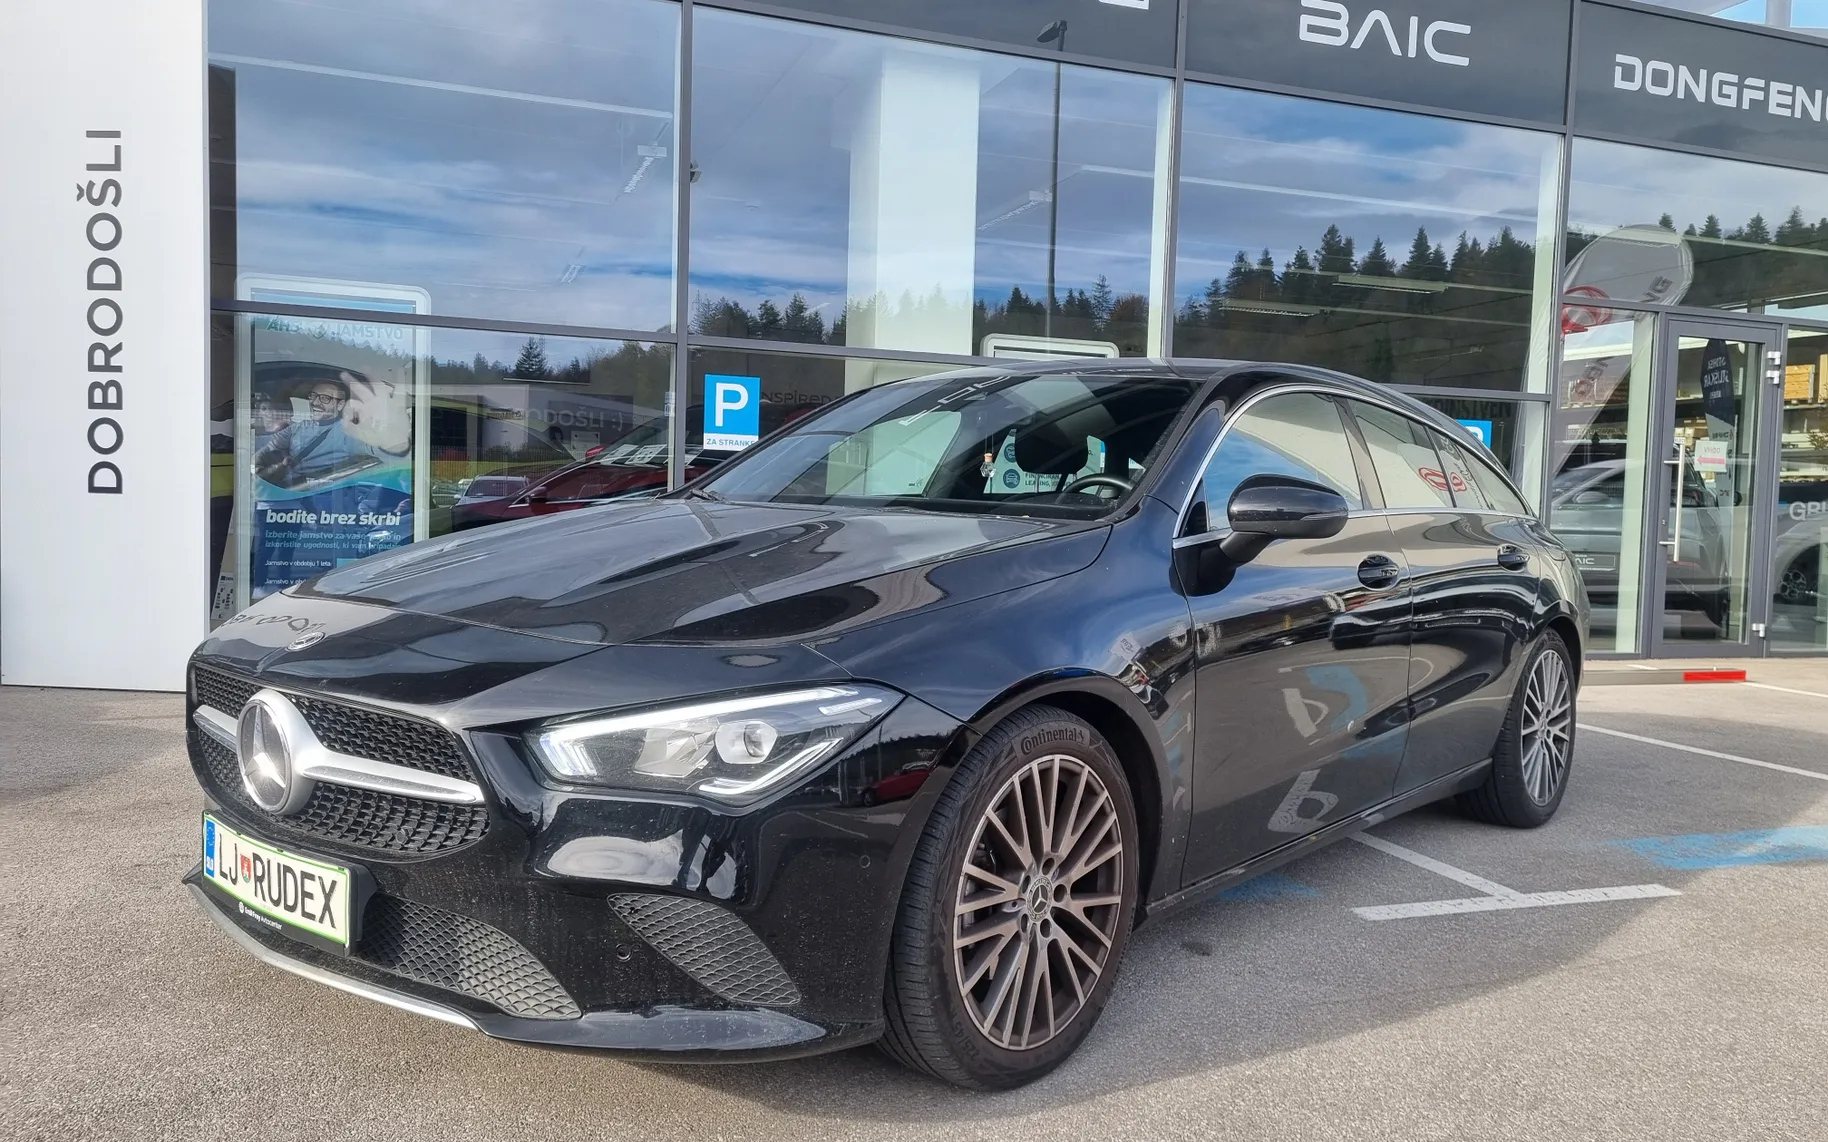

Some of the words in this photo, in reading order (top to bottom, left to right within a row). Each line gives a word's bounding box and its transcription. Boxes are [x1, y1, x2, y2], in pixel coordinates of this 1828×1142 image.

[1299, 0, 1471, 67] BAIC
[1613, 53, 1828, 122] DONGFEN
[76, 130, 124, 494] DOBRODOŠLI
[335, 323, 404, 340] JAMSTVO
[715, 382, 749, 427] P
[266, 509, 317, 524] bodite
[320, 510, 356, 525] brez
[359, 512, 401, 526] skrbi
[265, 530, 298, 539] izberite
[299, 530, 334, 540] jamstvo
[265, 541, 301, 549] izkoristite
[303, 541, 340, 550] ugodnosti,
[265, 559, 289, 567] Jamstvo
[1575, 557, 1595, 565] AIC
[1020, 727, 1077, 756] Continental
[219, 832, 239, 886] LJ
[252, 851, 338, 929] RUDEX
